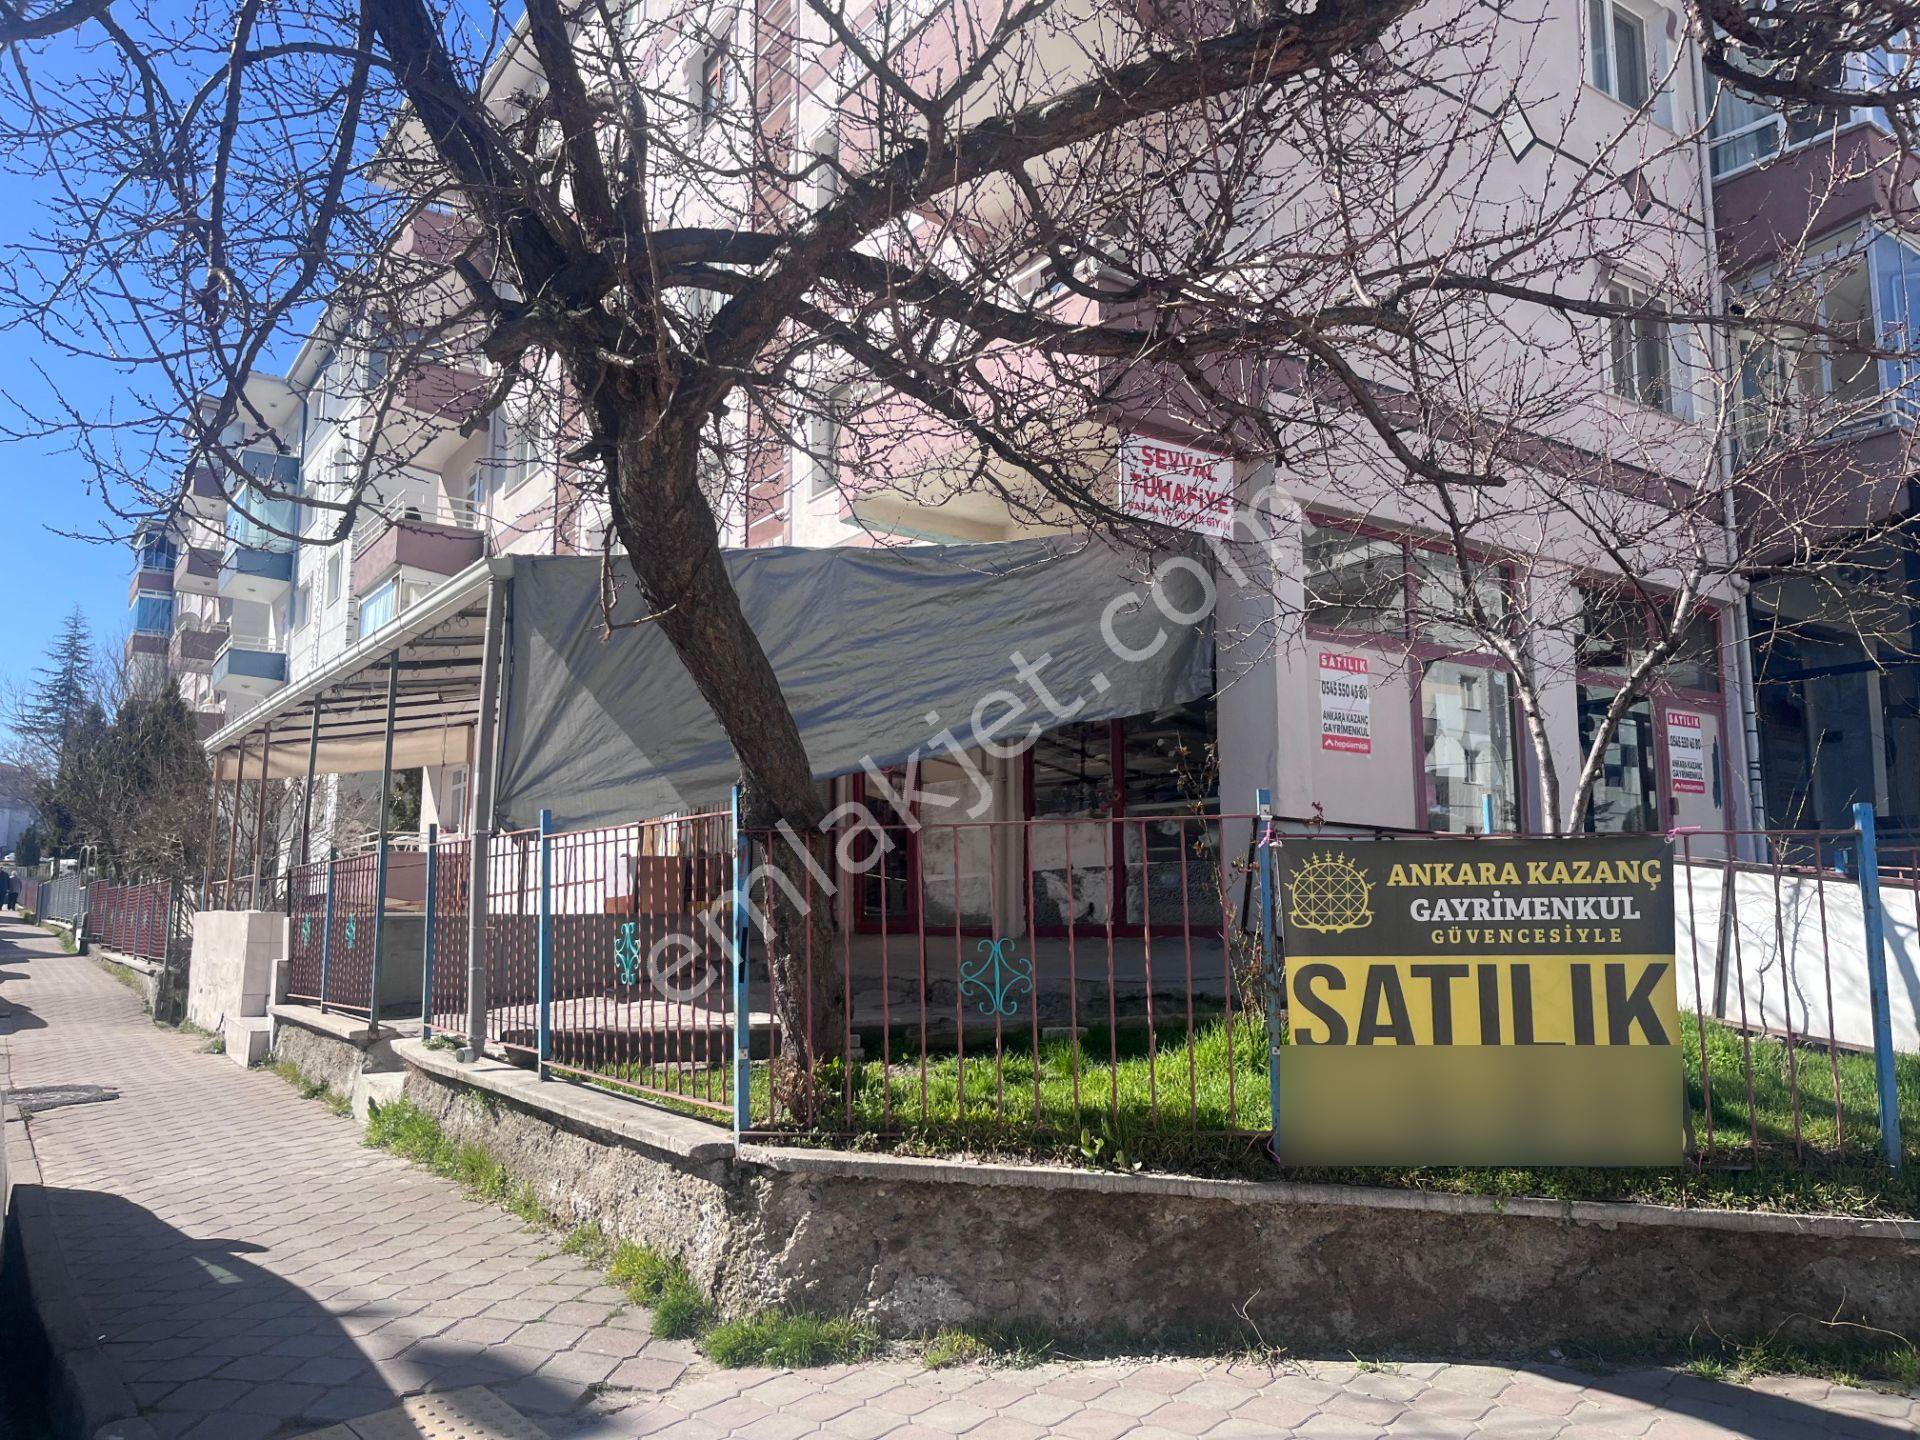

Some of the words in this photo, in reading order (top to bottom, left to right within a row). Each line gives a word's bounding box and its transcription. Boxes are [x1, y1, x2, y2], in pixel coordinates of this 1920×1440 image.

[1321, 654, 1366, 672] SATILIK
[1322, 710, 1345, 721] ANKARA
[1346, 712, 1369, 725] KAZANÇ
[1668, 713, 1700, 727] SATILIK
[1323, 722, 1370, 737] GAYRİMENKUL
[1386, 862, 1522, 886] ANKARA
[1527, 859, 1662, 892] KAZANÇ
[1410, 890, 1641, 922] GAYRİMENKUL
[1431, 924, 1622, 944] GÜVENCESİYLE
[1292, 963, 1671, 1046] SATILIK
